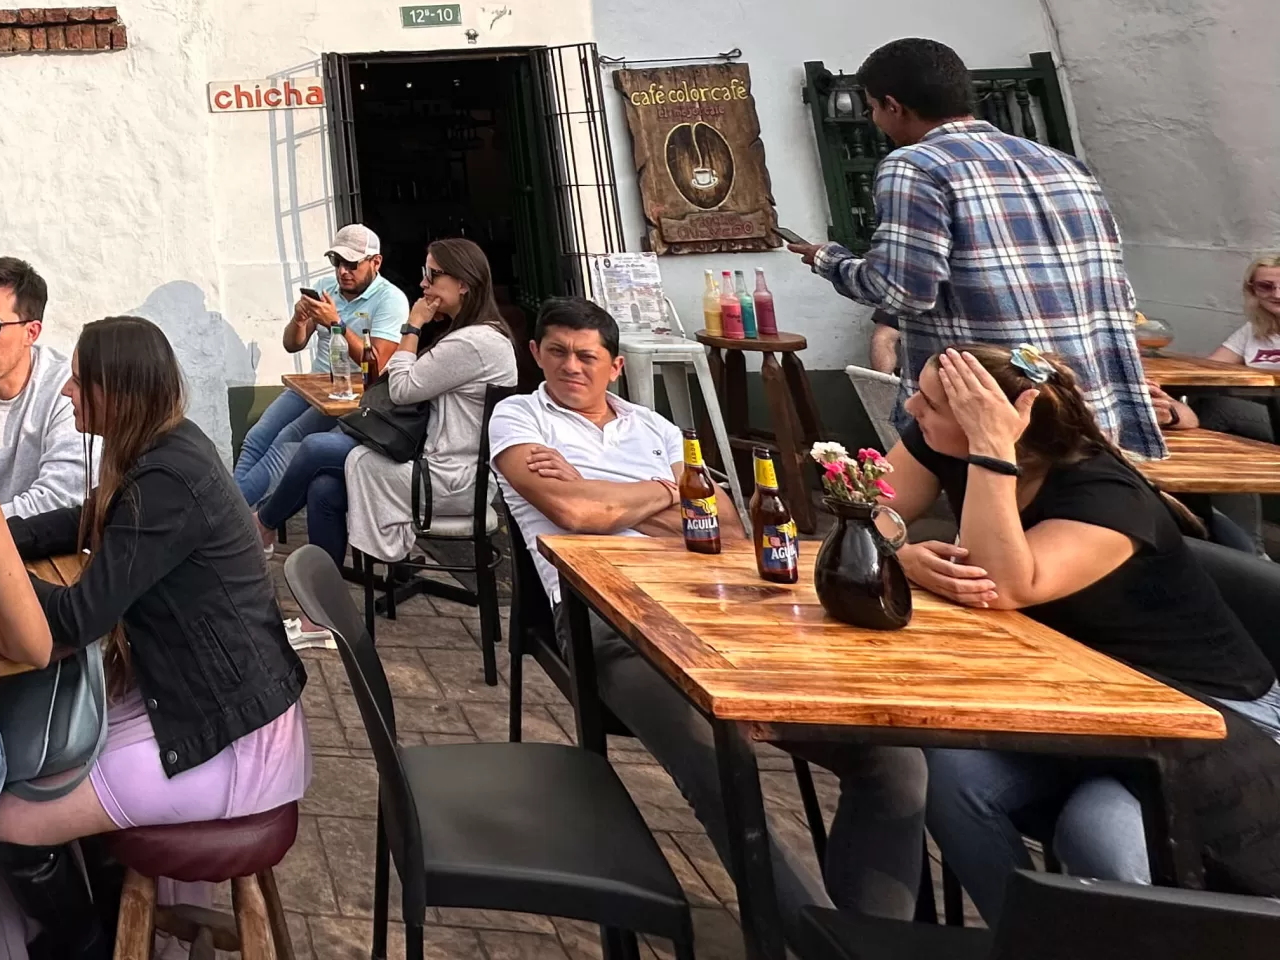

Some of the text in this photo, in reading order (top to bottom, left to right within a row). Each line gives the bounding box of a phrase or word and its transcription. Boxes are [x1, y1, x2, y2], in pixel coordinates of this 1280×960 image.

[214, 81, 324, 109] chicha
[631, 78, 749, 107] café color café
[687, 516, 718, 530] AGUILA
